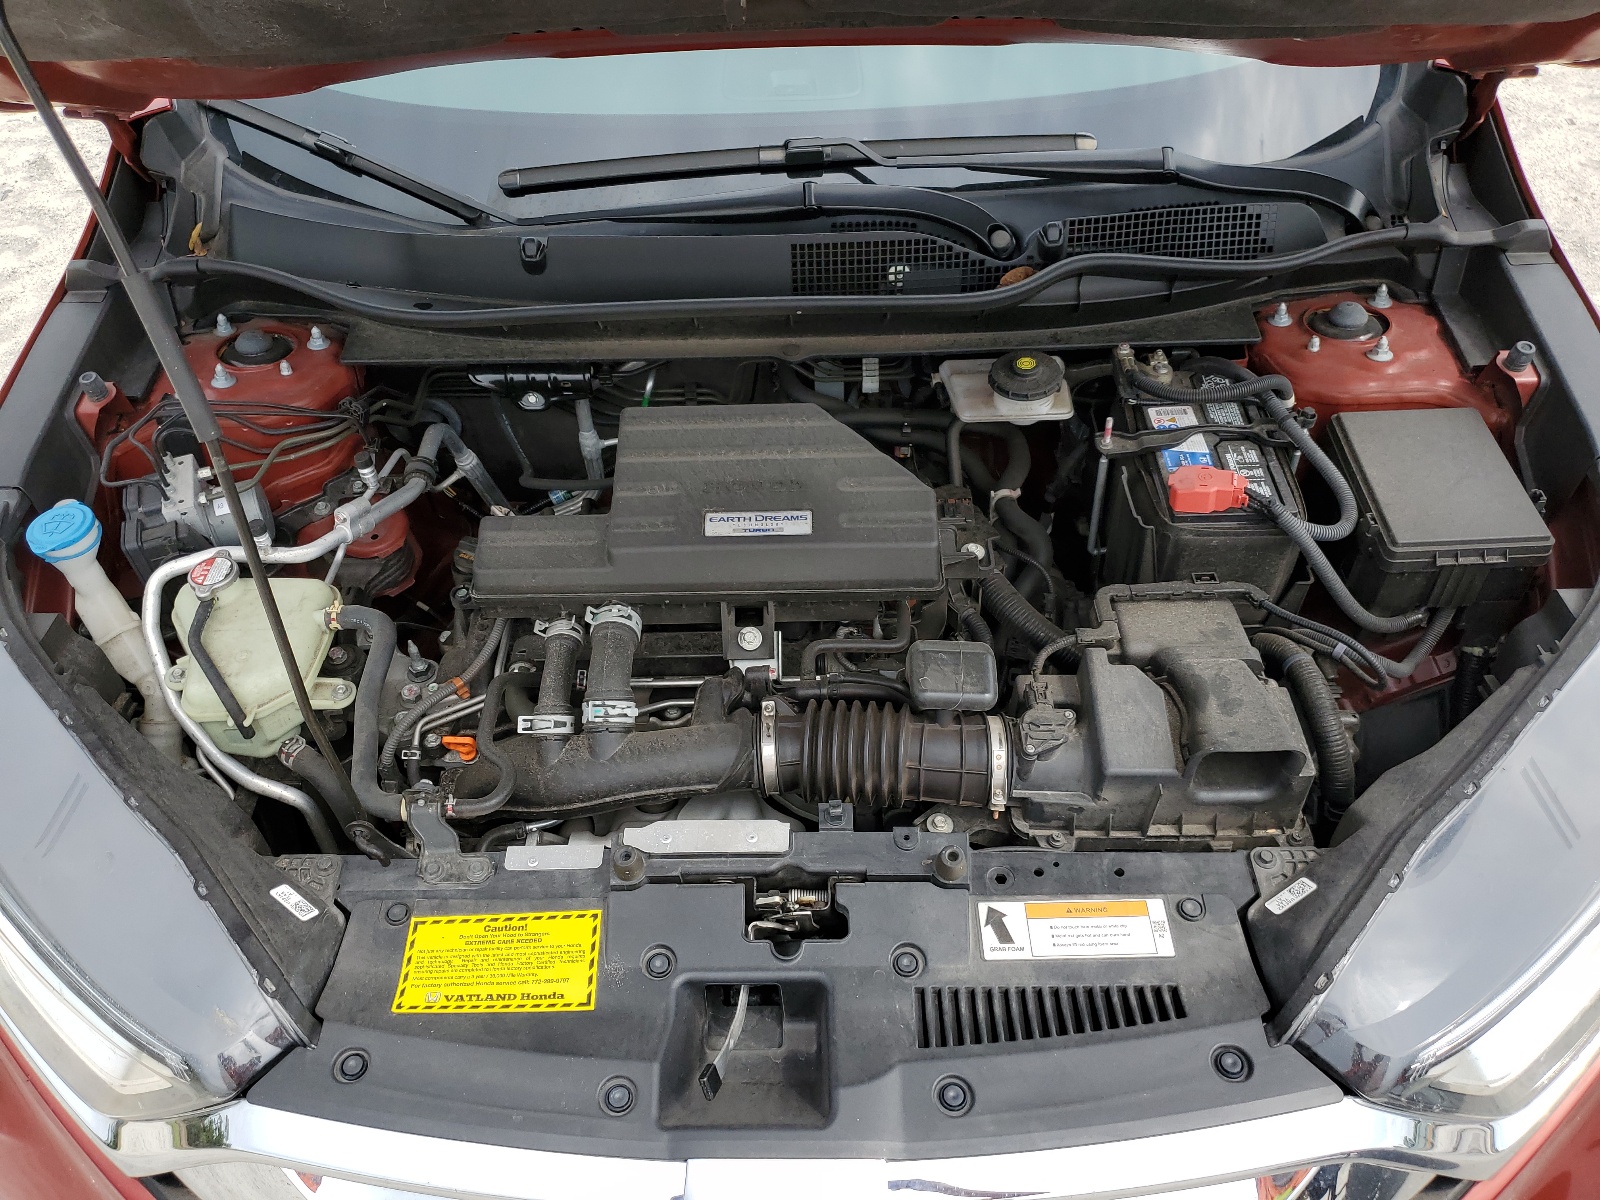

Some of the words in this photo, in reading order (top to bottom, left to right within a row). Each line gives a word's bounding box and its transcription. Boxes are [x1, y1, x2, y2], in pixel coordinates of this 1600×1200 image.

[754, 514, 808, 522] DREAMS
[483, 924, 528, 933] Caution!
[443, 993, 518, 1002] VATLAND
[520, 991, 565, 1001] Honda
